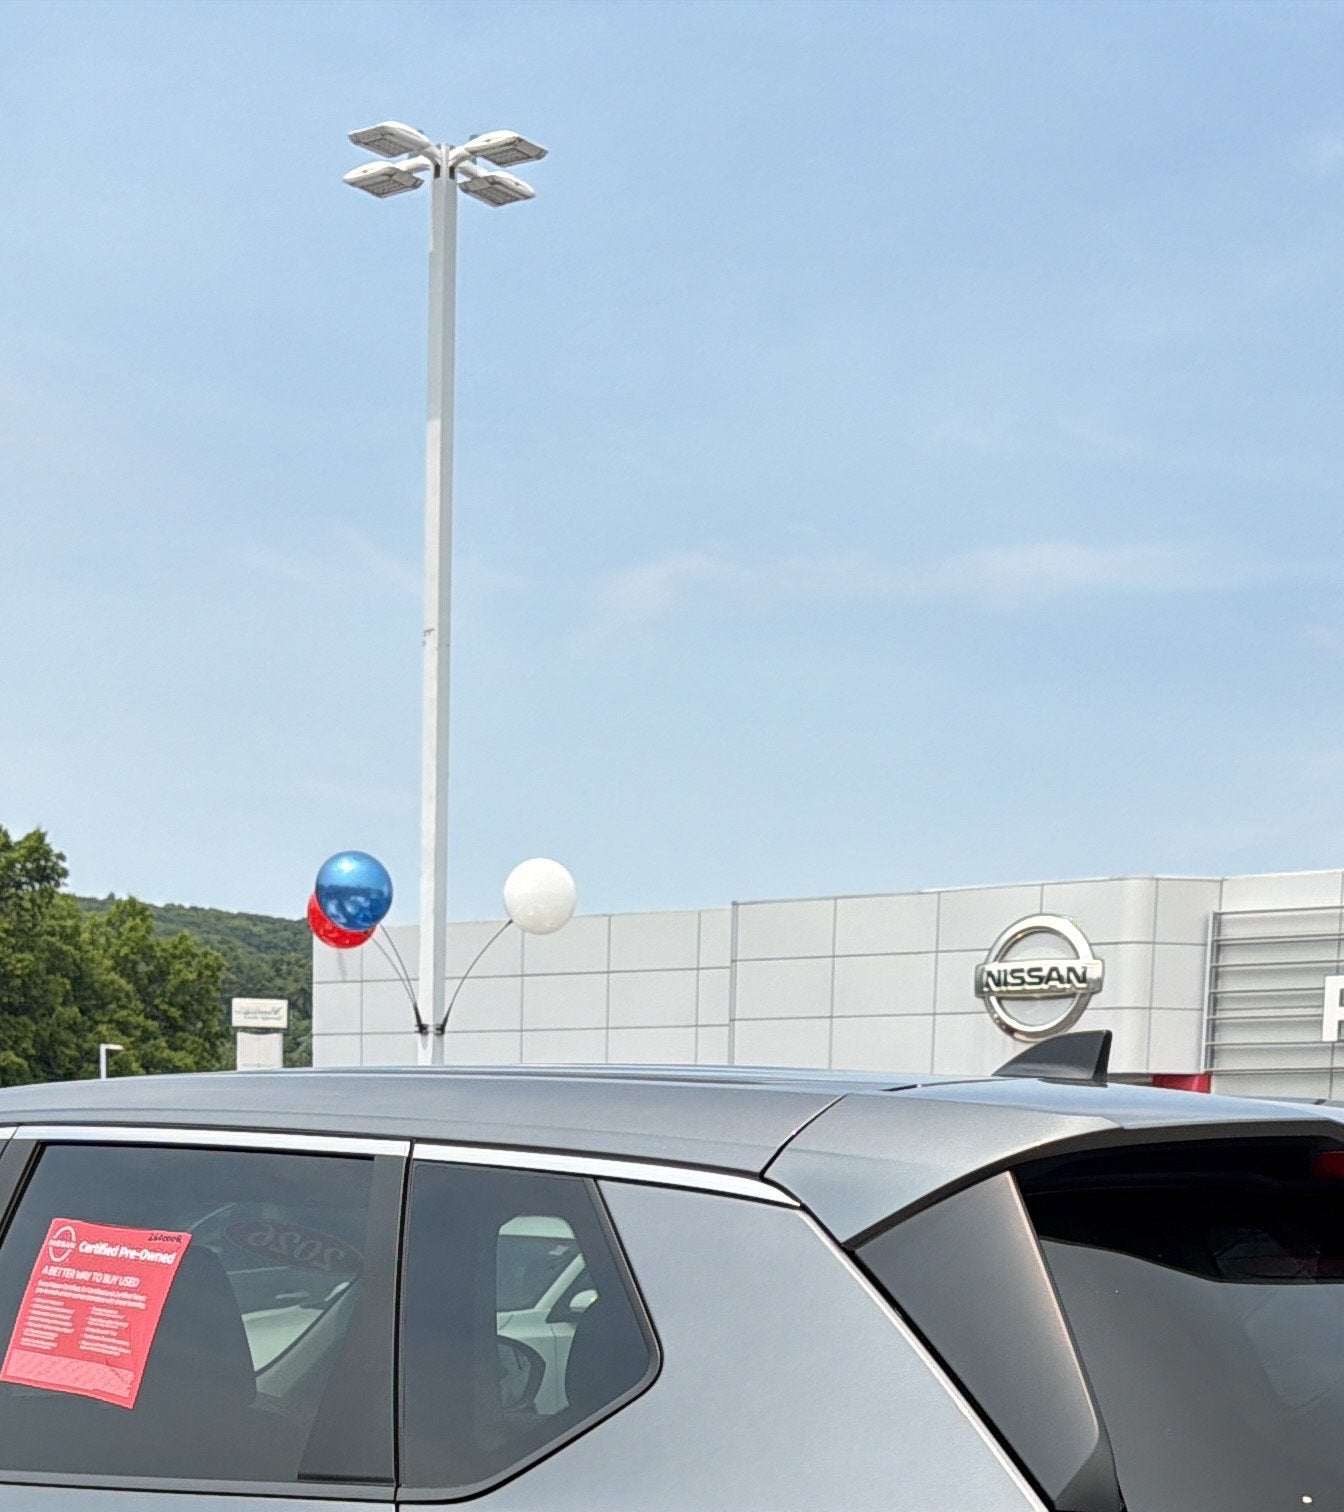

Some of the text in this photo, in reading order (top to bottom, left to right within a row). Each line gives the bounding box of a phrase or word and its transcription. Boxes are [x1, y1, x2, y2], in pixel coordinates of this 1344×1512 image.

[983, 966, 1088, 988] NISSAN
[78, 1241, 176, 1265] Certified Pre-Owned
